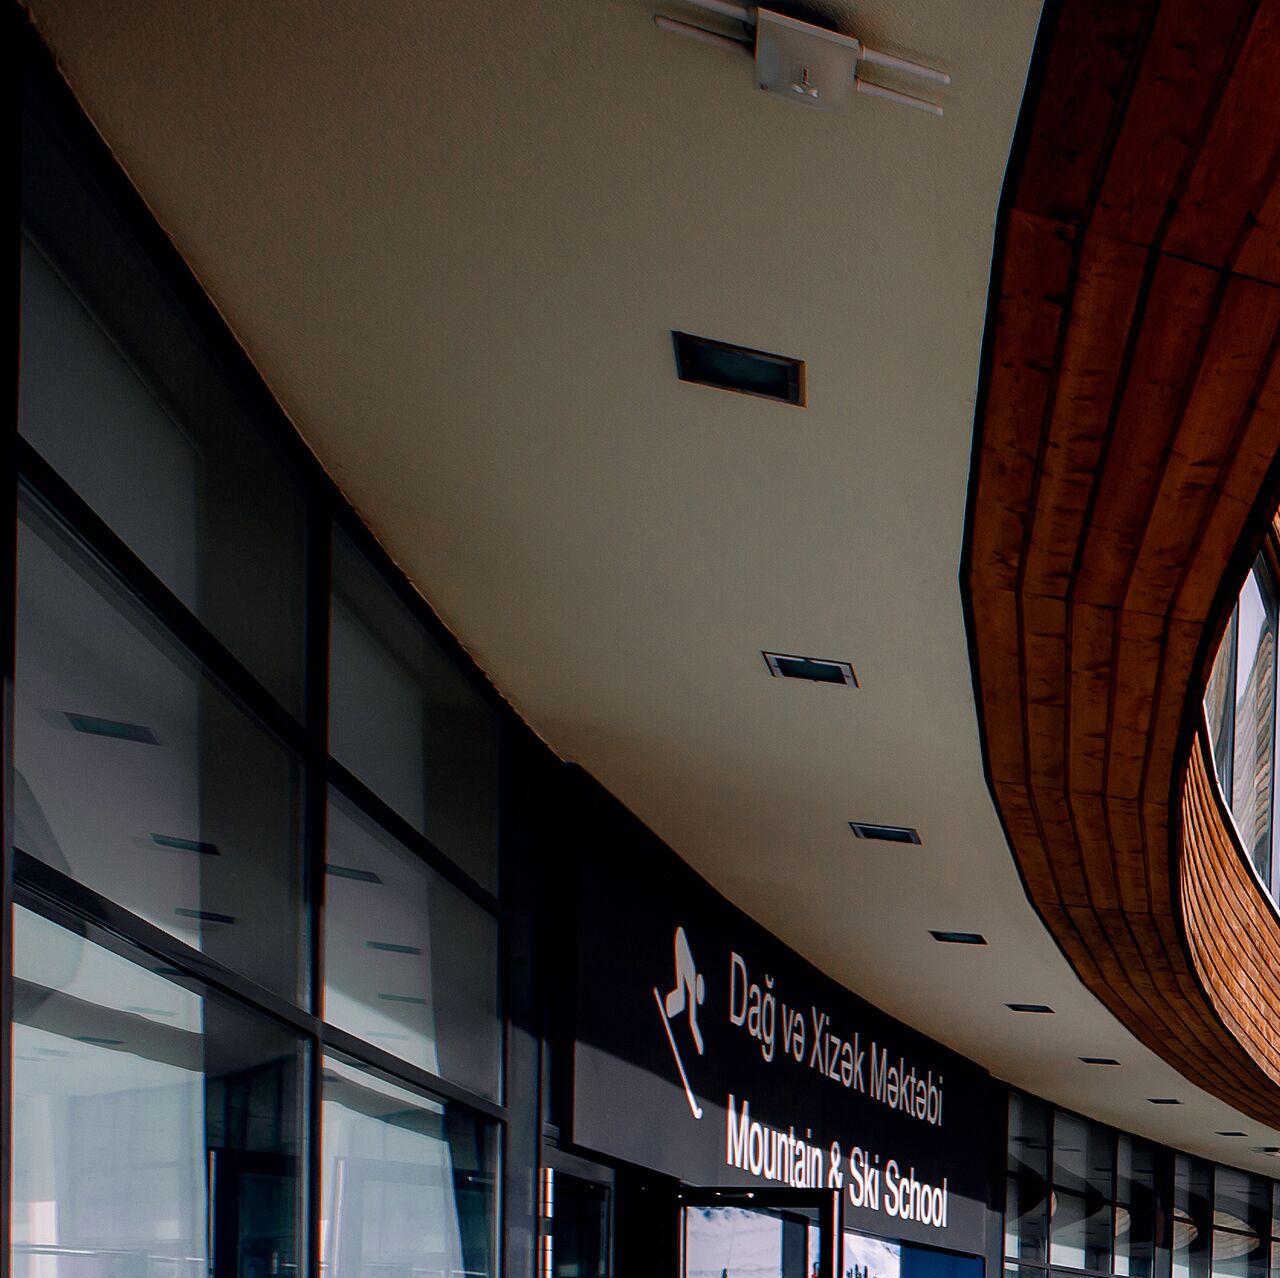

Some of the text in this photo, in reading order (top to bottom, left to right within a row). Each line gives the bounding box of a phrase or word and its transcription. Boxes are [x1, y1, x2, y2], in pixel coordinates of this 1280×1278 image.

[730, 951, 943, 1126] Dağ və Xizək Məktəbi
[726, 1093, 948, 1228] Mountain & Ski School
